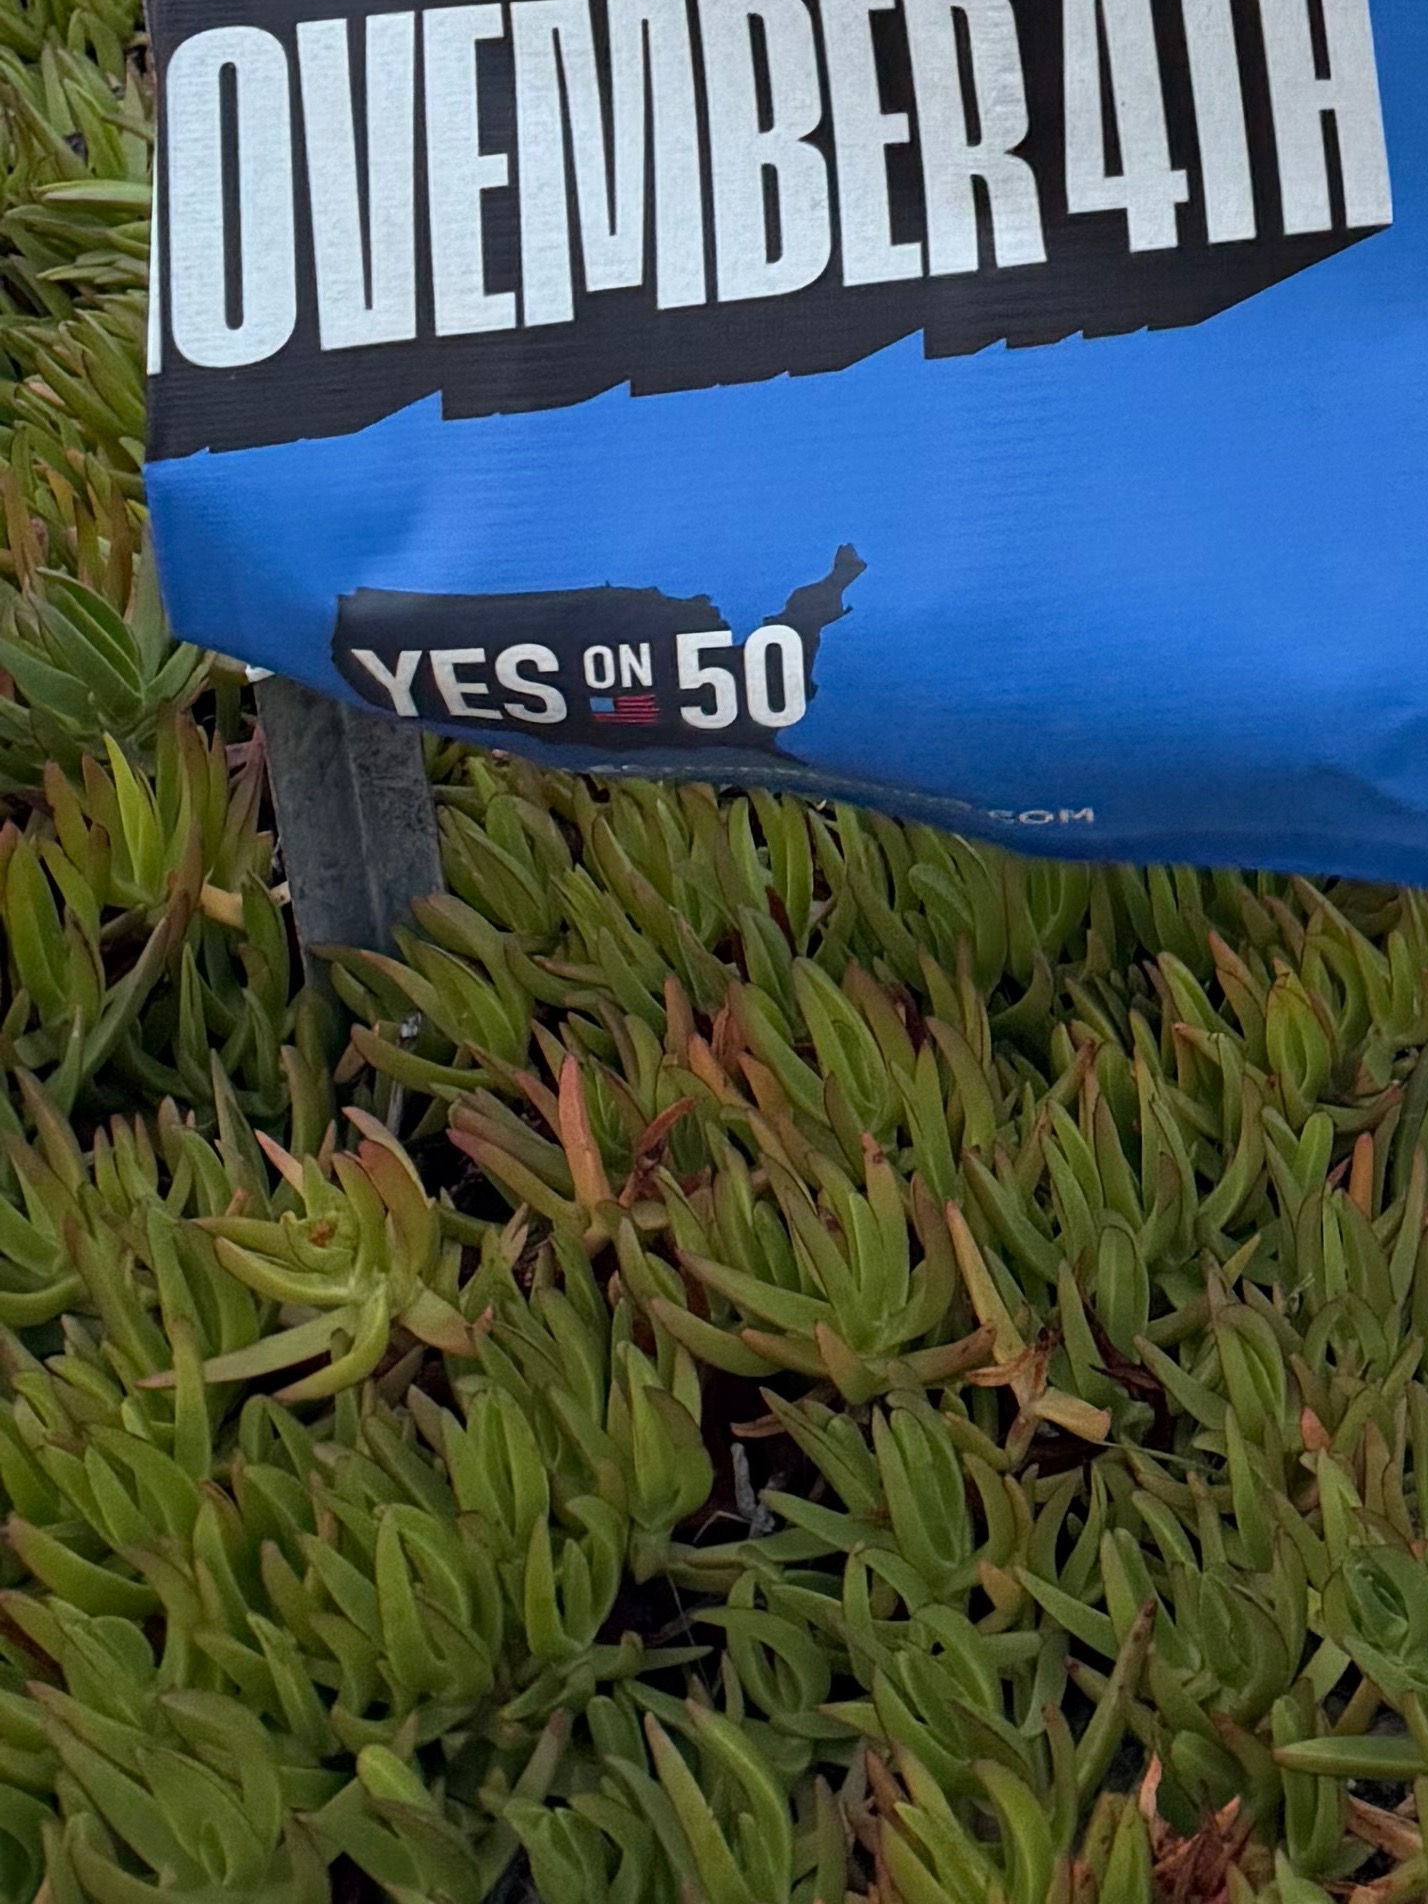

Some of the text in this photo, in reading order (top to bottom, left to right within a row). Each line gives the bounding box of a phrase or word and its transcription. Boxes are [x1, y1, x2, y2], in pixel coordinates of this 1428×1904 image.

[350, 624, 807, 731] YES ON 50
